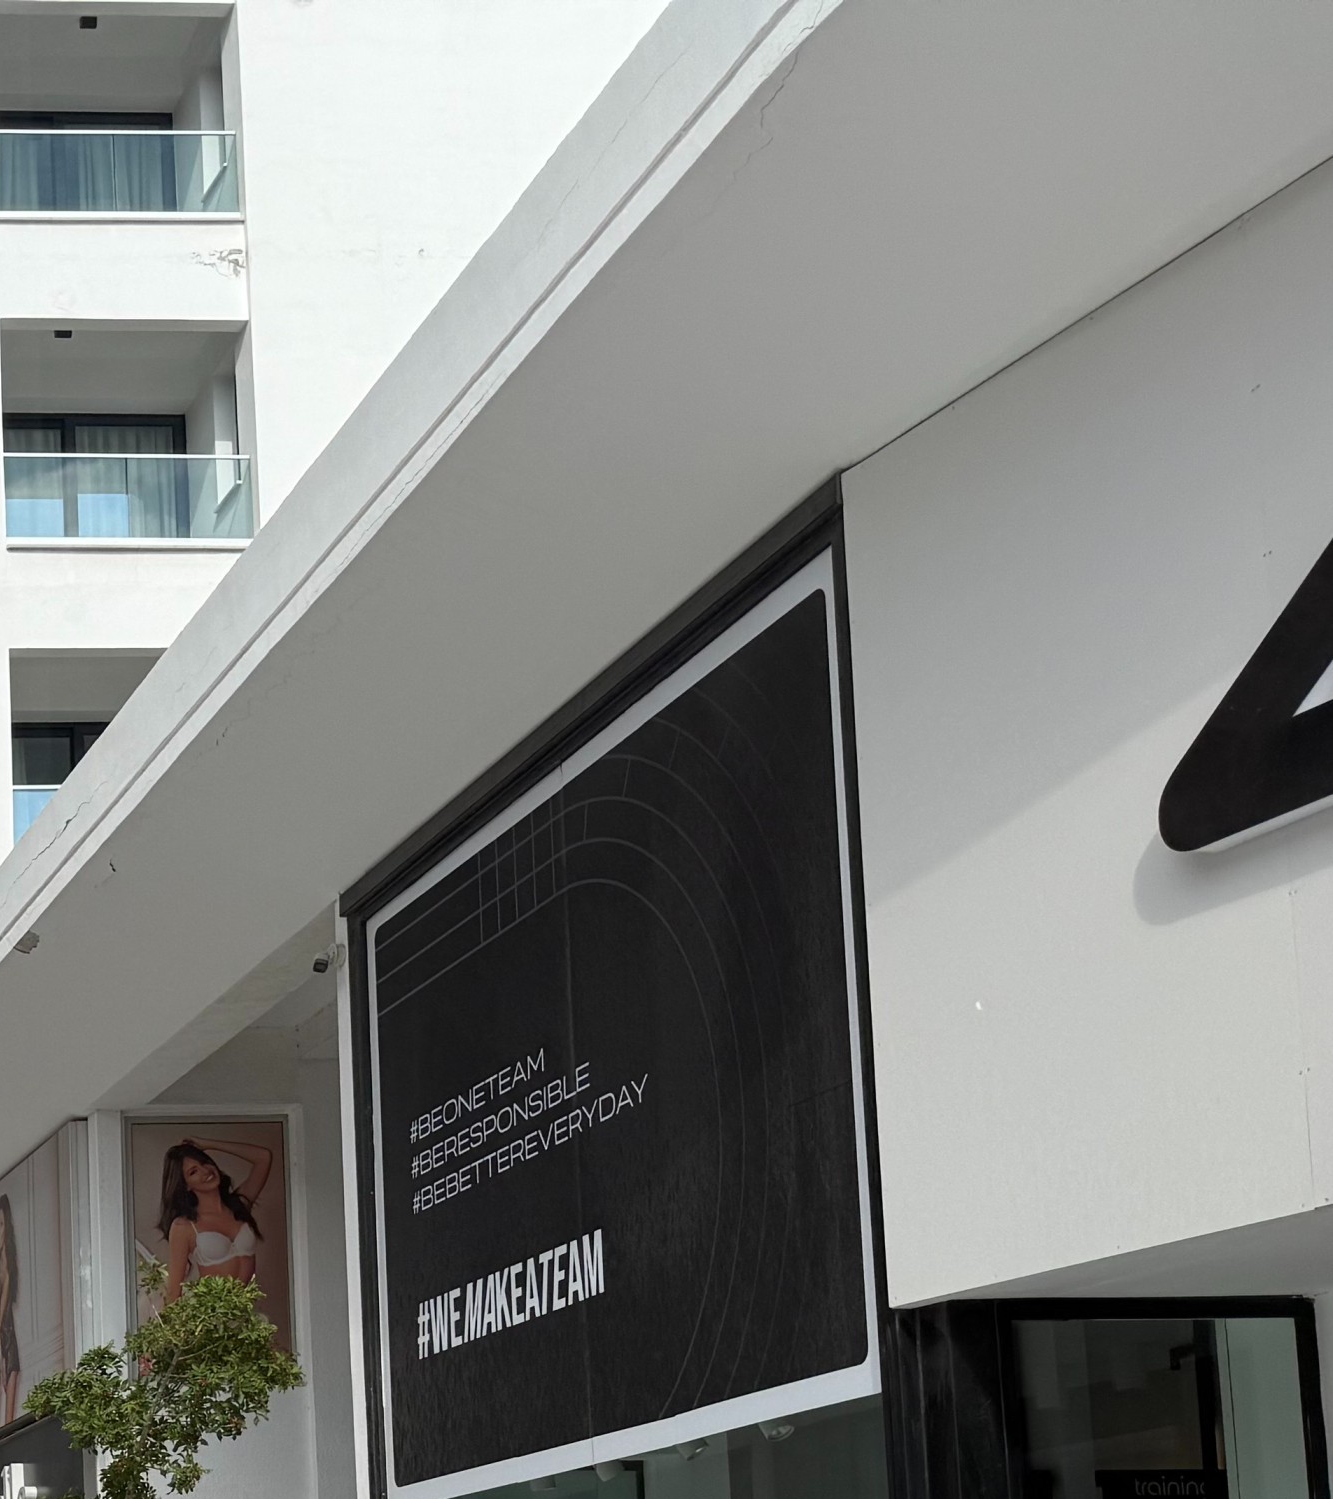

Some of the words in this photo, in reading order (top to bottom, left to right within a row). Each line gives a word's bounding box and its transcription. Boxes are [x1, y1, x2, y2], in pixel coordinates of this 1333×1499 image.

[409, 1048, 545, 1144] #BEONETEAM
[411, 1062, 591, 1179] #BERESPONSIBLE
[412, 1073, 649, 1215] #BEBETTEREVERYDAY
